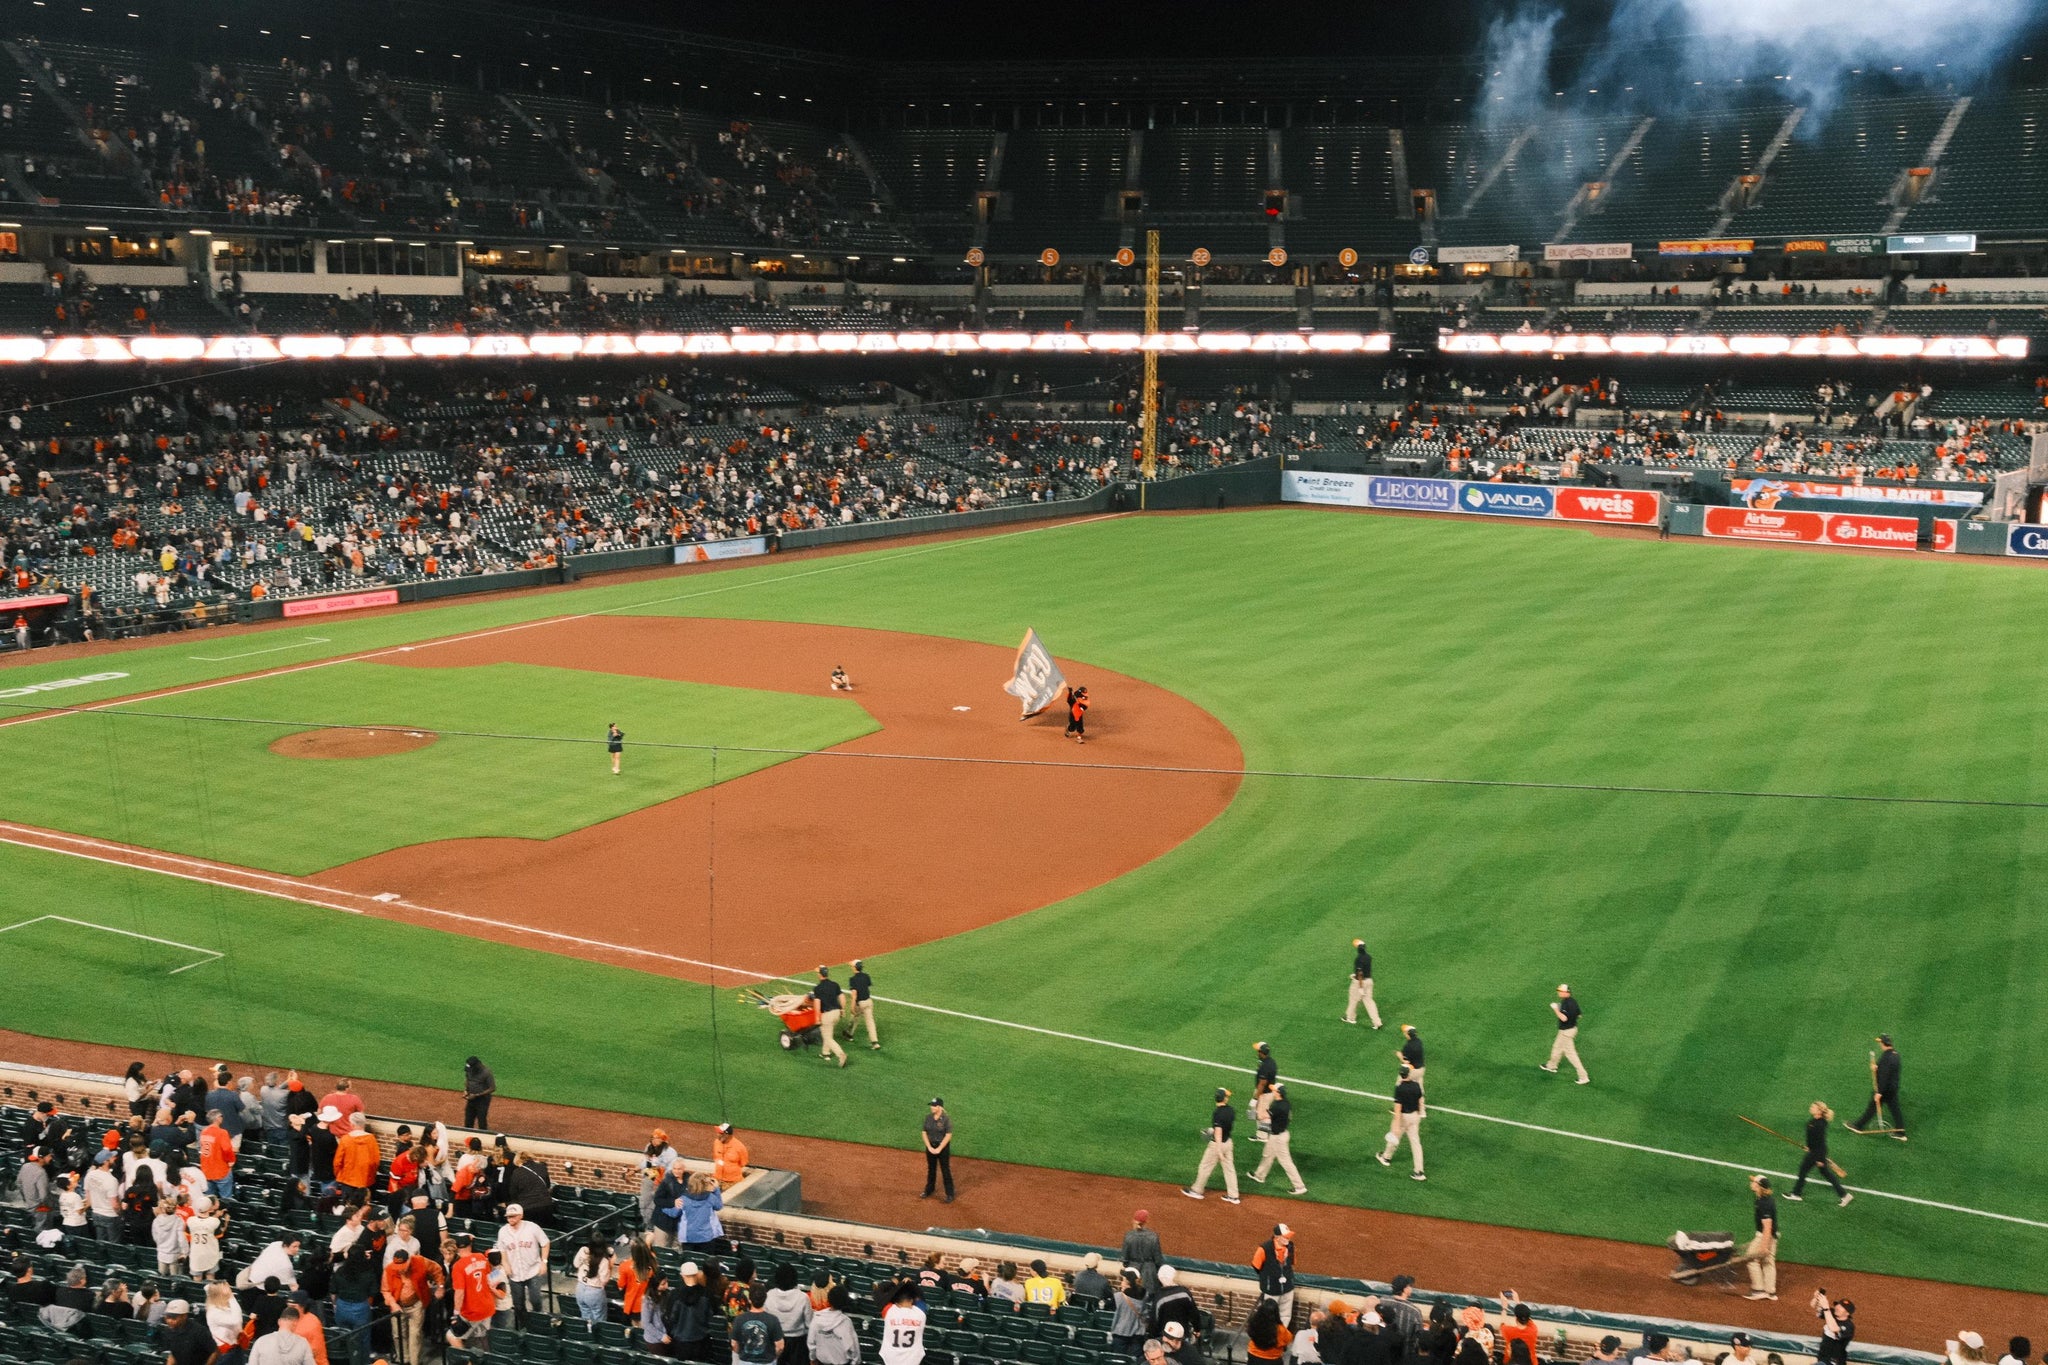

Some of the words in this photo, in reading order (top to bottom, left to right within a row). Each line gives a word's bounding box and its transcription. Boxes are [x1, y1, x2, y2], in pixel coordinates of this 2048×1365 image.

[1046, 252, 1054, 262] 5
[1122, 252, 1130, 262] 4
[1193, 252, 1209, 262] 22
[1411, 252, 1426, 262] 42
[1376, 482, 1449, 501] LECOM
[1841, 486, 1884, 499] BIRD
[1885, 488, 1932, 501] BATH
[1484, 492, 1546, 508] VANDA
[1577, 494, 1635, 513] weis
[194, 1233, 208, 1245] 35
[1031, 1287, 1053, 1302] 19
[892, 1329, 915, 1348] 13
